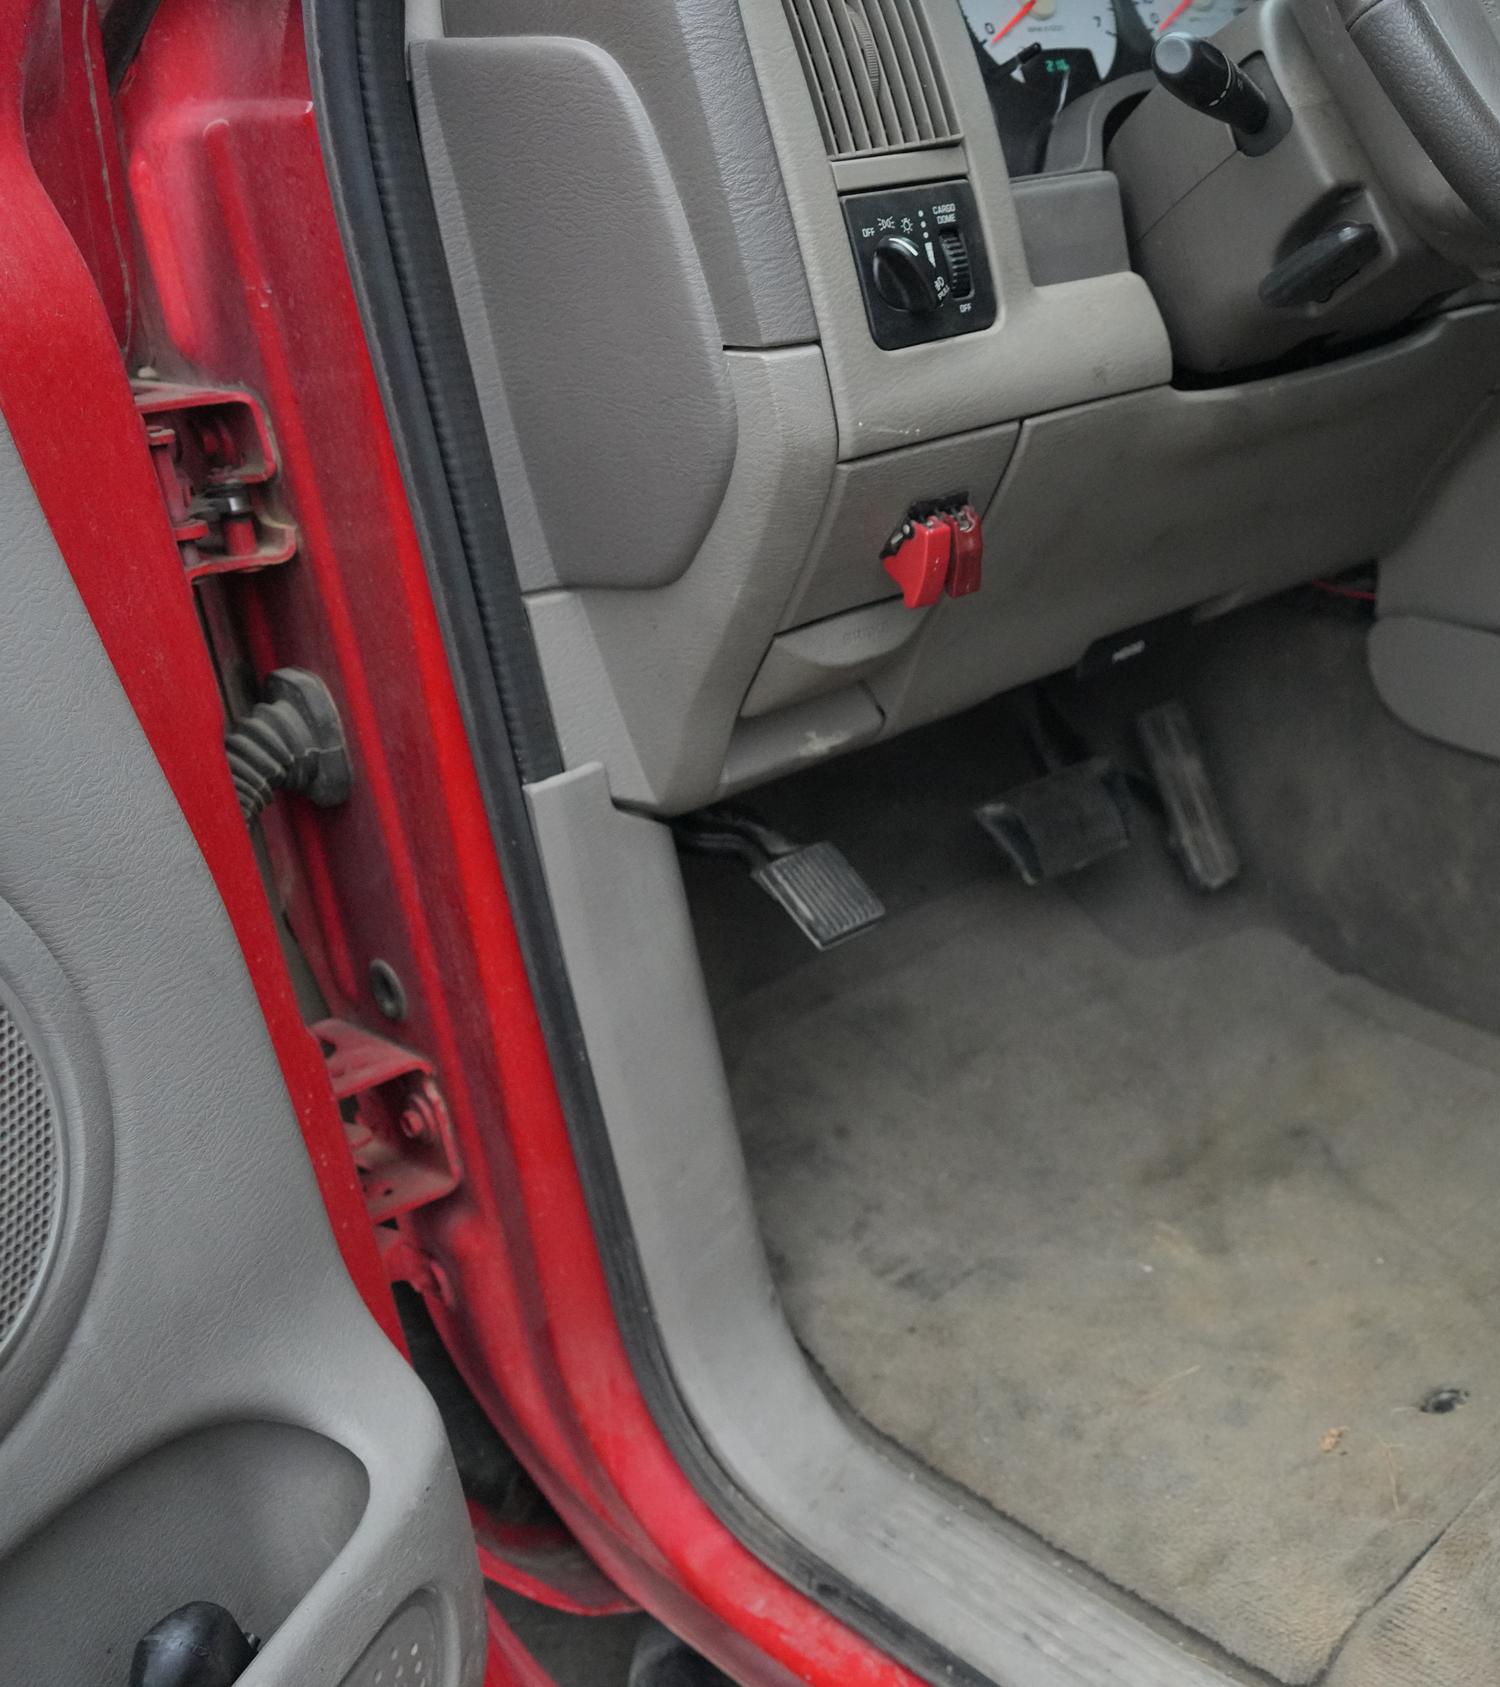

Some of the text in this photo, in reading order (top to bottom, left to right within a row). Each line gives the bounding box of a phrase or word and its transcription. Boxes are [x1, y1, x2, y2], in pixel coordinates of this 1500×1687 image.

[984, 22, 996, 35] 0
[932, 203, 956, 215] CARGO
[936, 214, 957, 225] DOME
[862, 227, 875, 238] OFF
[959, 303, 972, 313] OFF
